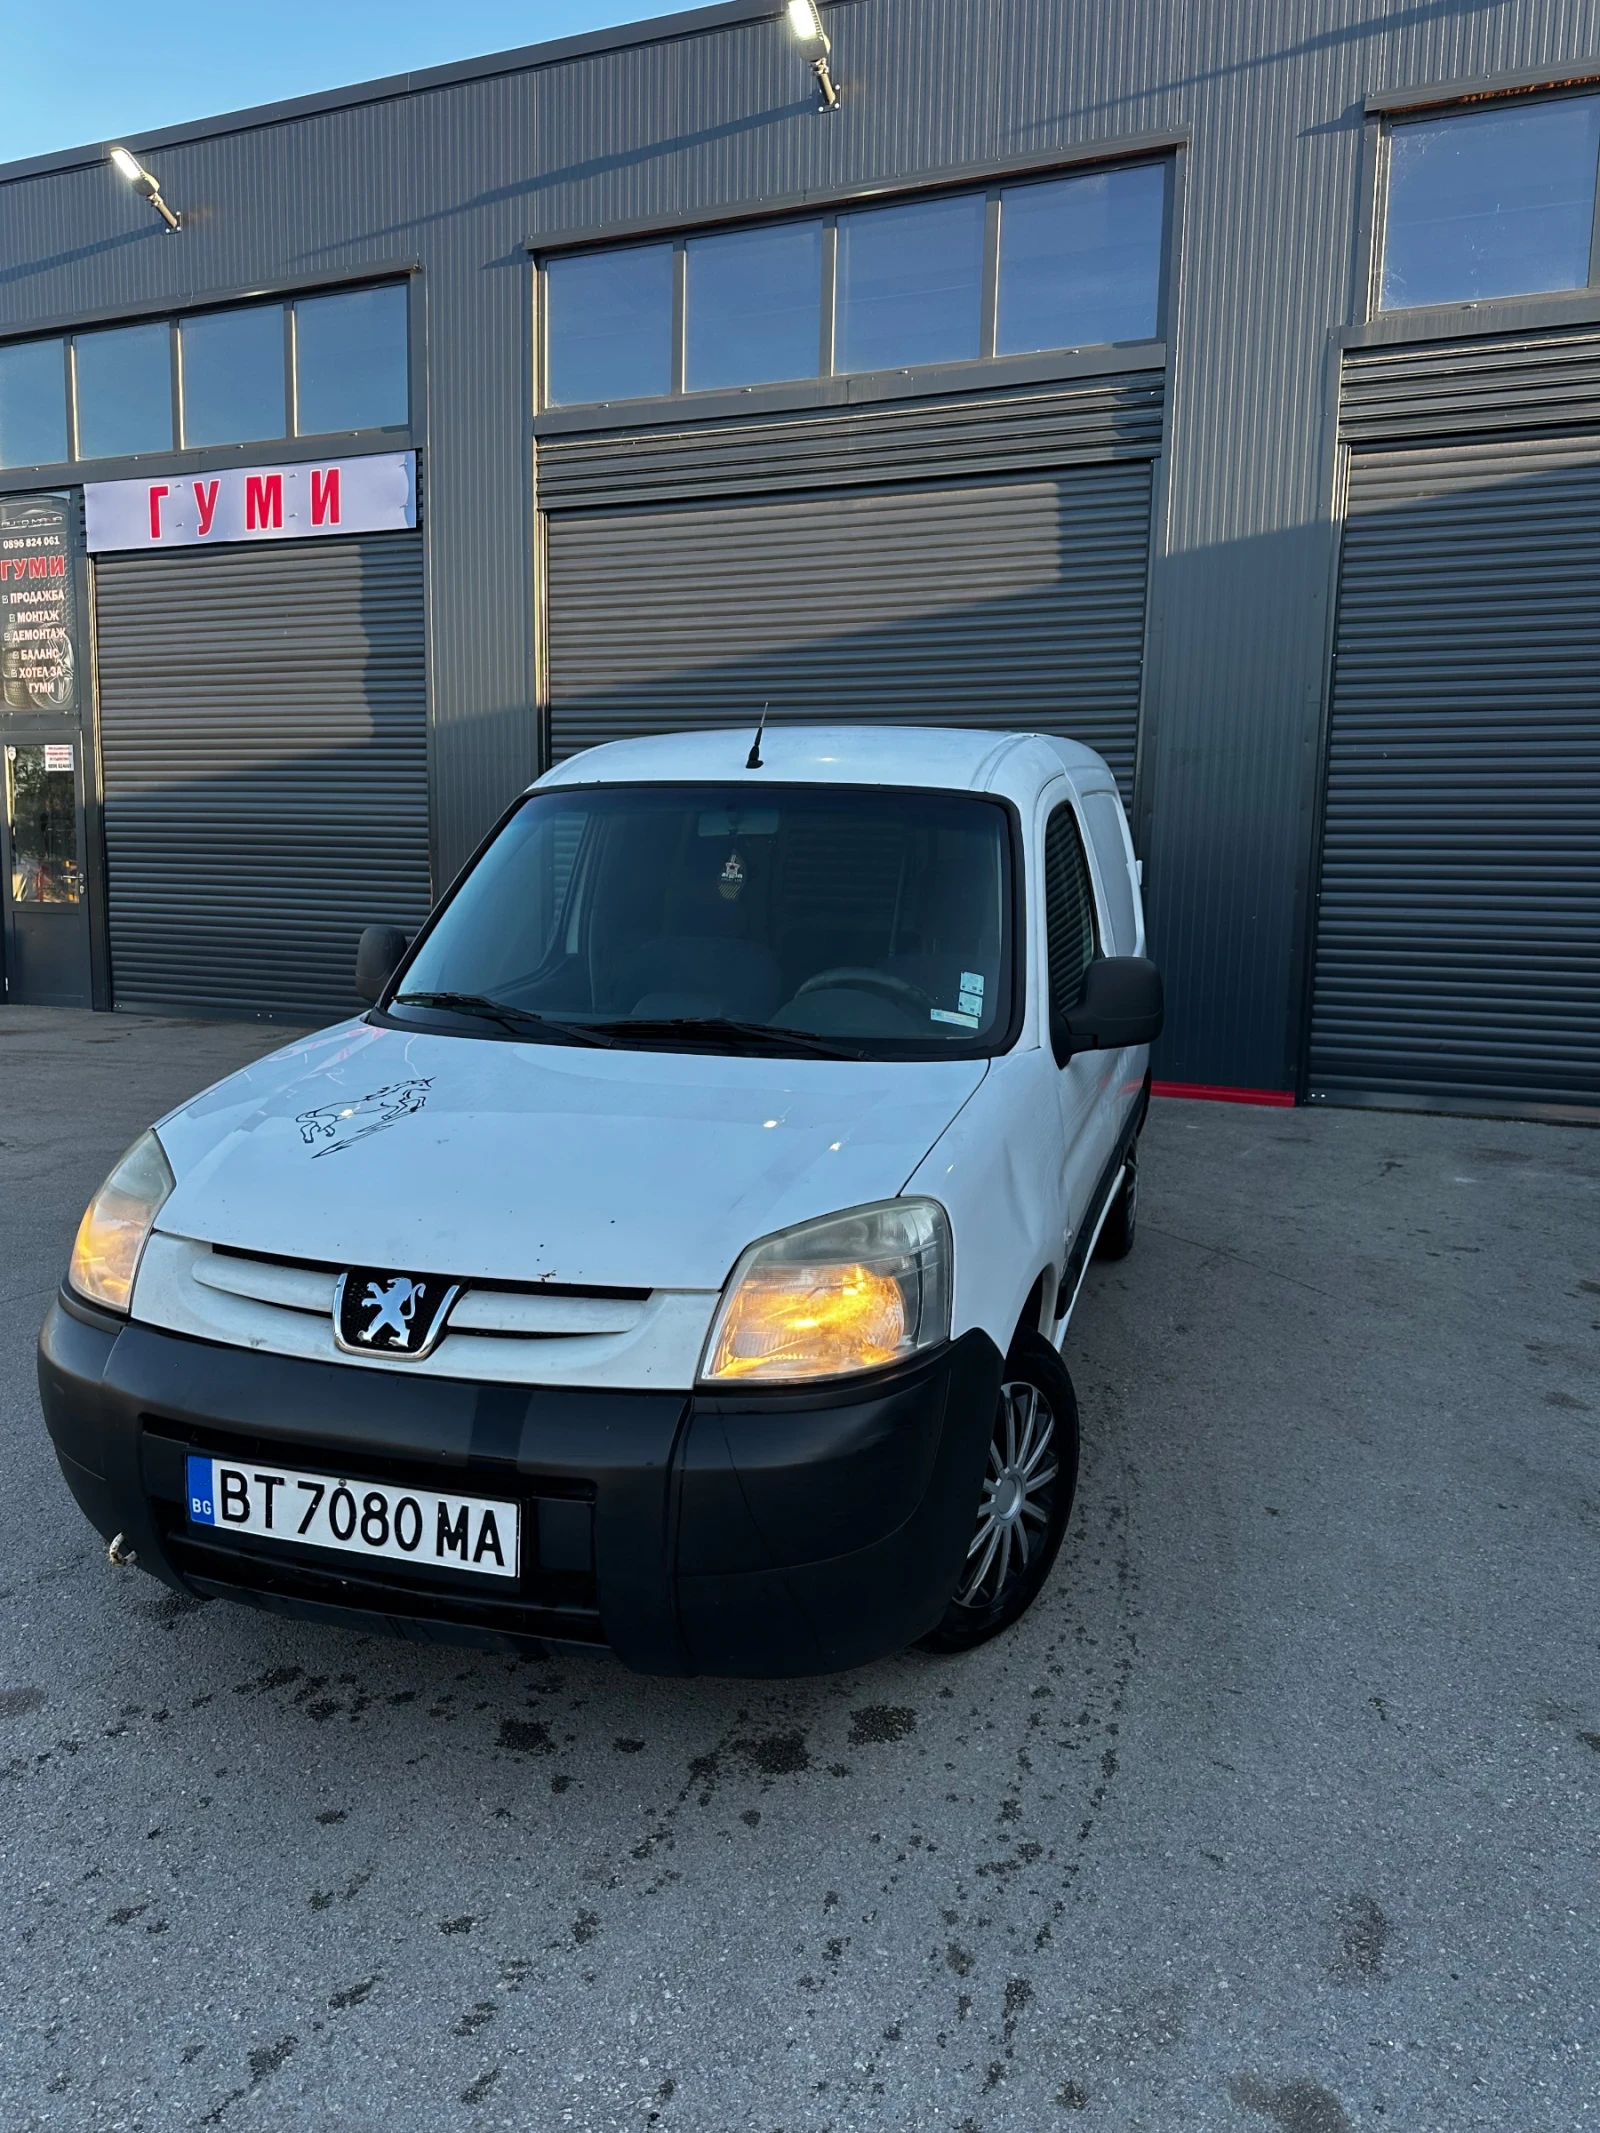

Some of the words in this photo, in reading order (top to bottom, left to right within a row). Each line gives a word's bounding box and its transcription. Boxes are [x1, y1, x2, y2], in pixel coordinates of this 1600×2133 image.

[148, 467, 341, 540] ГУМИ
[3, 539, 24, 549] 0896
[26, 537, 42, 547] 824
[43, 535, 60, 546] 061
[0, 556, 65, 580] ГУМИ
[10, 589, 65, 604] ПРОДАЖБА
[17, 610, 60, 623] МОНТАЖ
[12, 628, 66, 643] ДЕМОНТАЖ
[21, 648, 60, 660] БАЛАНС
[18, 666, 49, 678] ХОТЕЛ
[50, 666, 63, 677] ЗА
[28, 682, 55, 693] ГУМИ
[192, 1498, 212, 1515] BG
[220, 1468, 285, 1529] BT
[297, 1481, 423, 1552] 7080
[436, 1500, 505, 1567] MA
